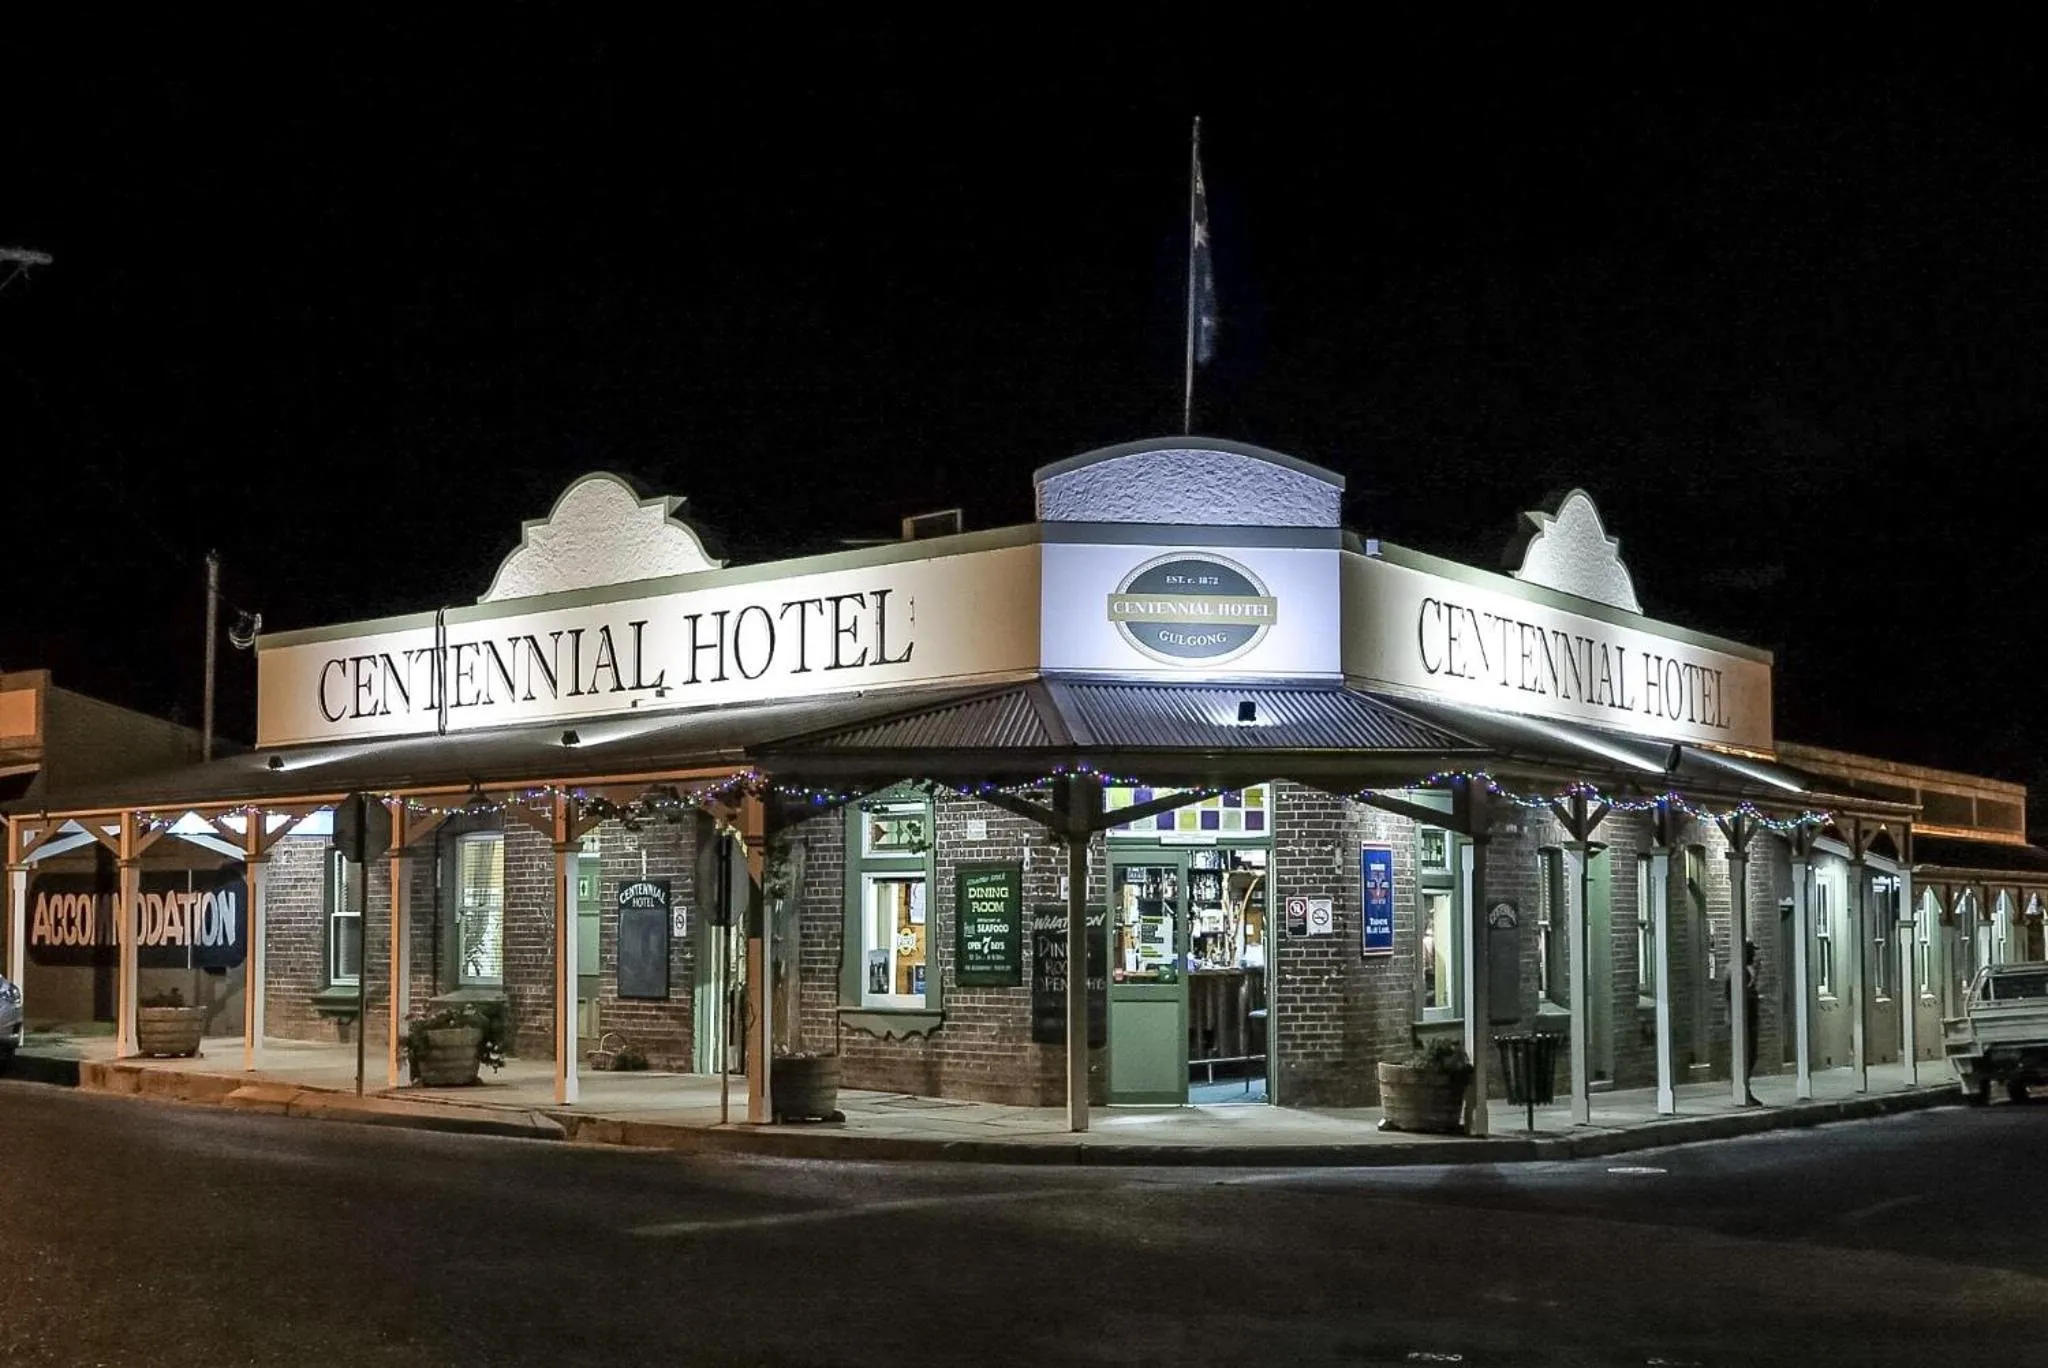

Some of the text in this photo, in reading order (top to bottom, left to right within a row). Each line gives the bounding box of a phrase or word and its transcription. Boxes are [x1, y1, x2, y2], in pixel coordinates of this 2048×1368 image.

[1113, 601, 1274, 618] CENTENNIAL HOTEL
[1158, 630, 1228, 647] GULGONG
[317, 588, 914, 723] CENTENNIAL HOTEL
[1418, 597, 1730, 730] CENTENNIAL HOTEL
[619, 883, 665, 905] CENTENNIAL
[967, 886, 1009, 899] DINING
[632, 896, 655, 908] HOTEL
[971, 901, 1004, 913] ROOM
[982, 935, 992, 955] 7
